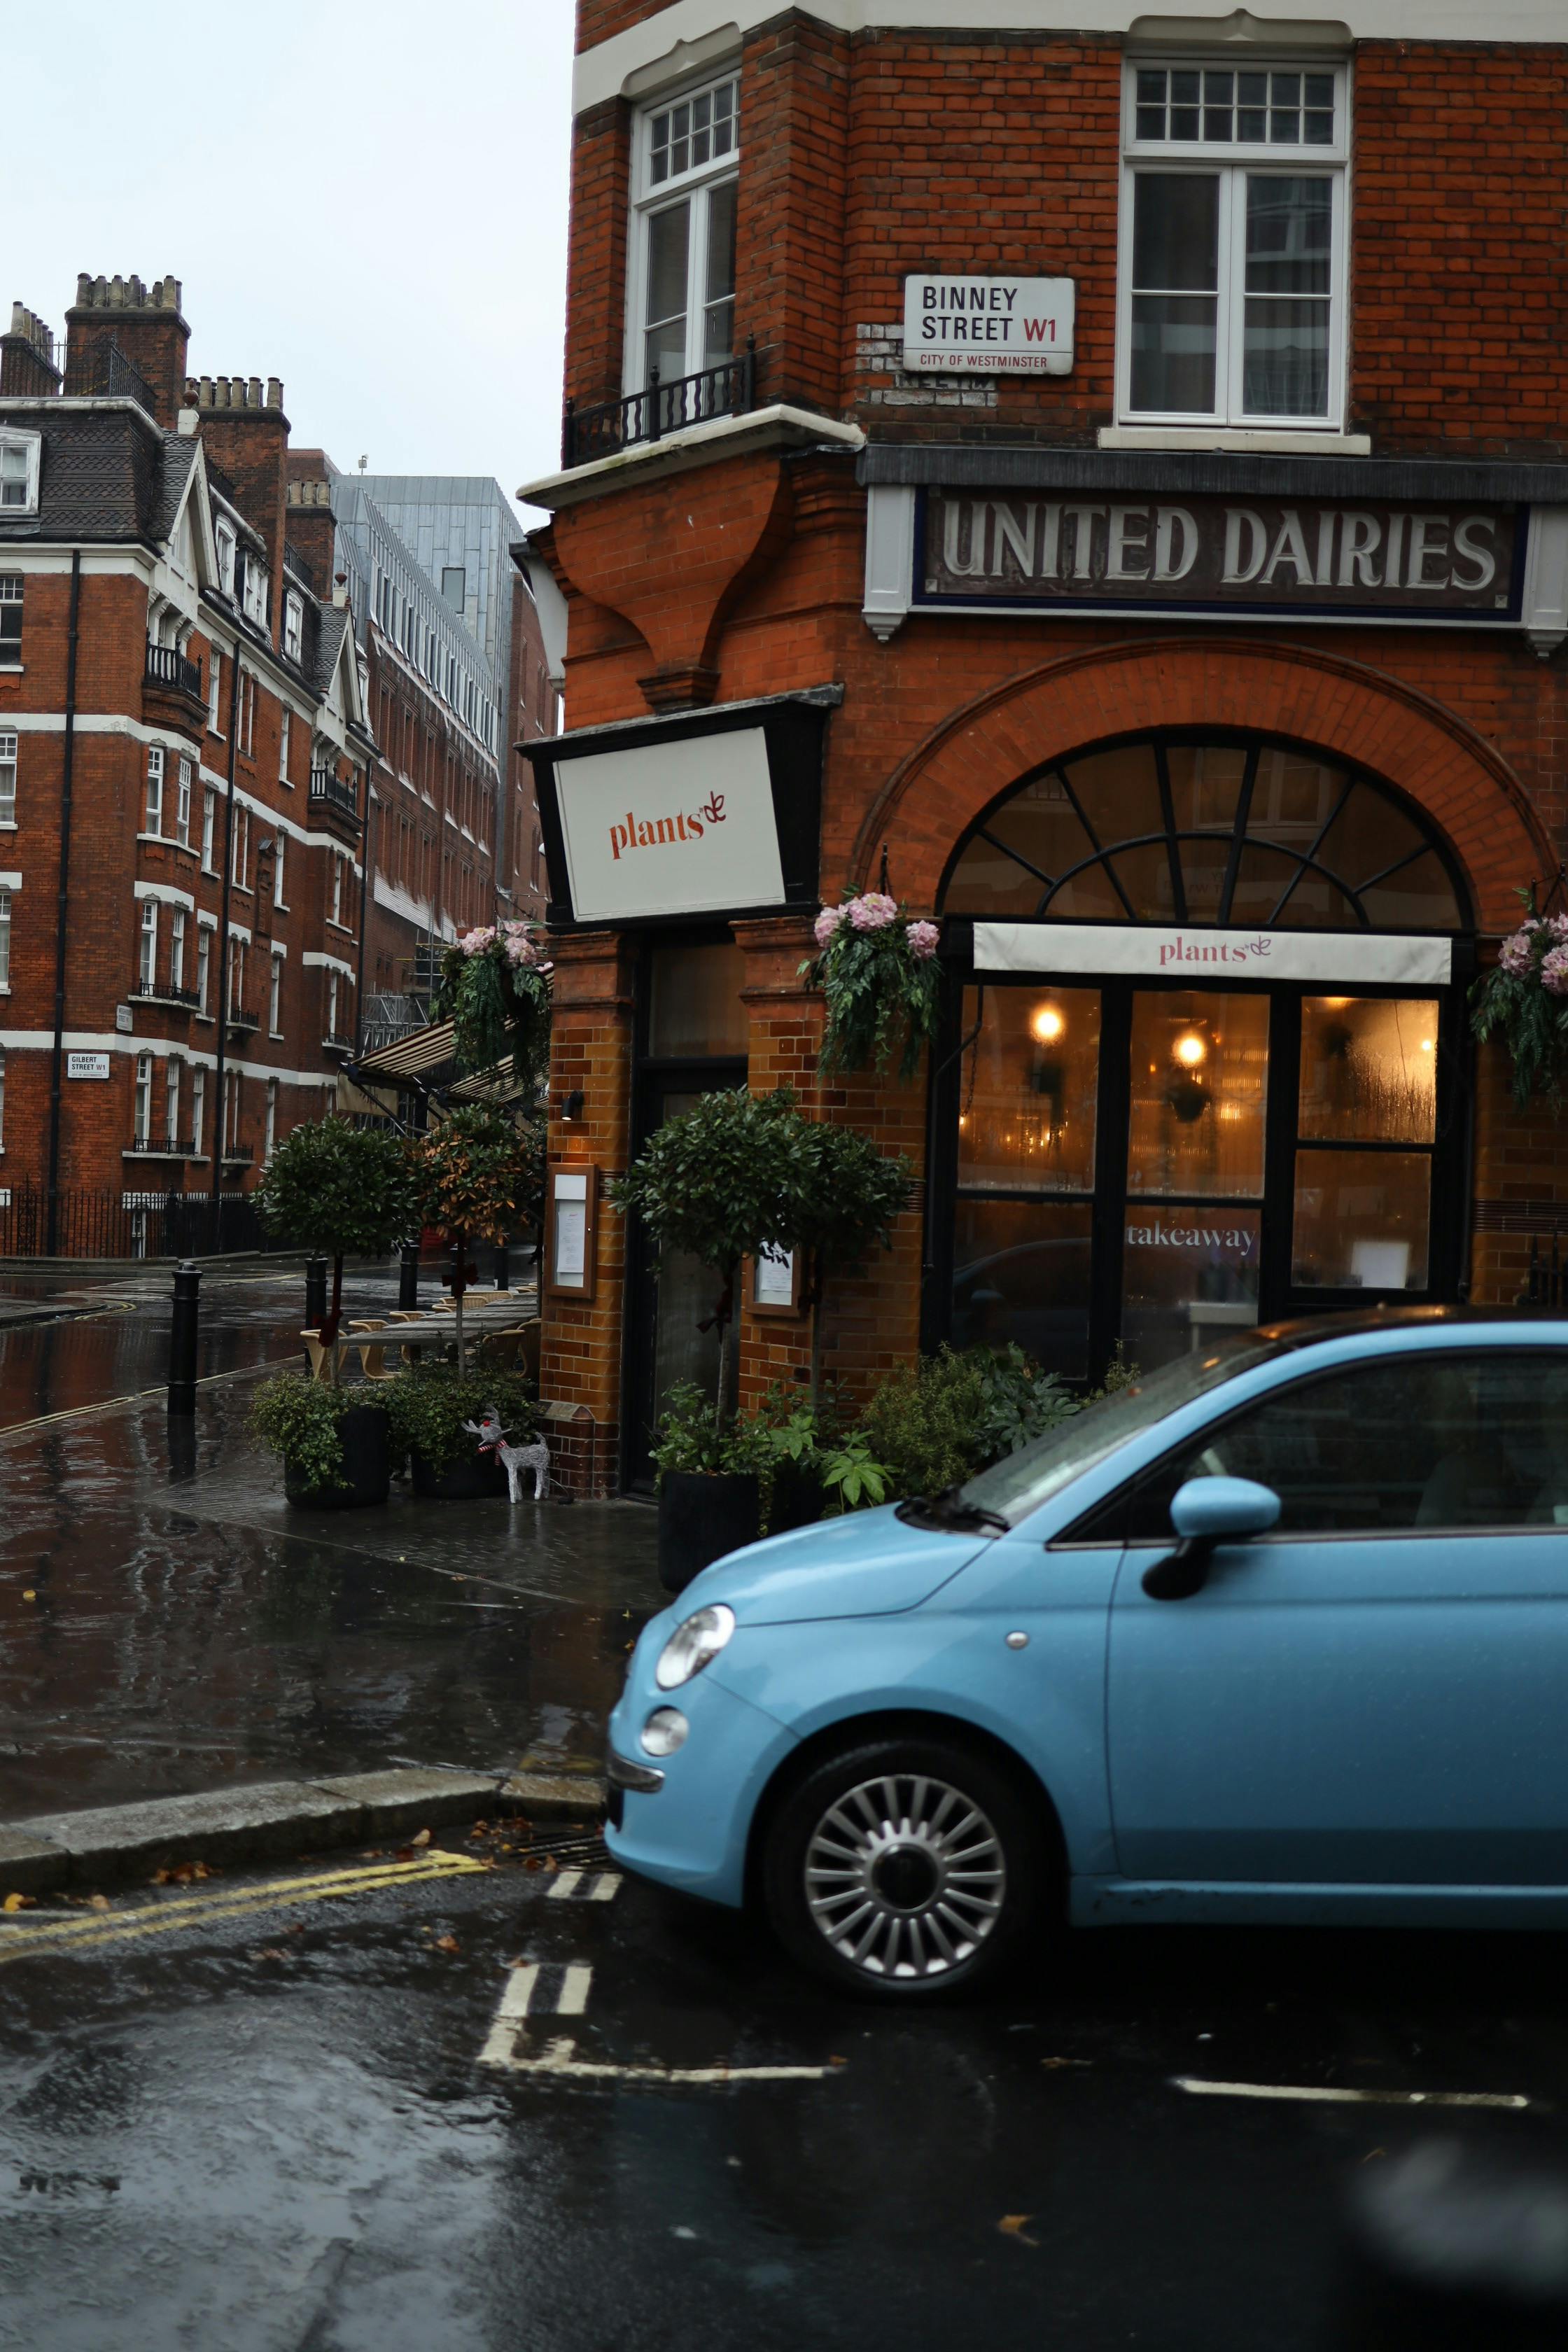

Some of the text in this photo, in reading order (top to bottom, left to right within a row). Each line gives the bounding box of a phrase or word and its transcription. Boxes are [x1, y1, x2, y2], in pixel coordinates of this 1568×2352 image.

[922, 286, 1018, 312] BINNEY
[921, 316, 1056, 342] STREET W1
[920, 354, 1047, 368] CITY OF WESTMINSTER
[943, 499, 1497, 592] UNITED DAIRIES
[608, 807, 705, 860] plants
[1158, 936, 1247, 966] plants
[1126, 1220, 1256, 1256] takeaway
